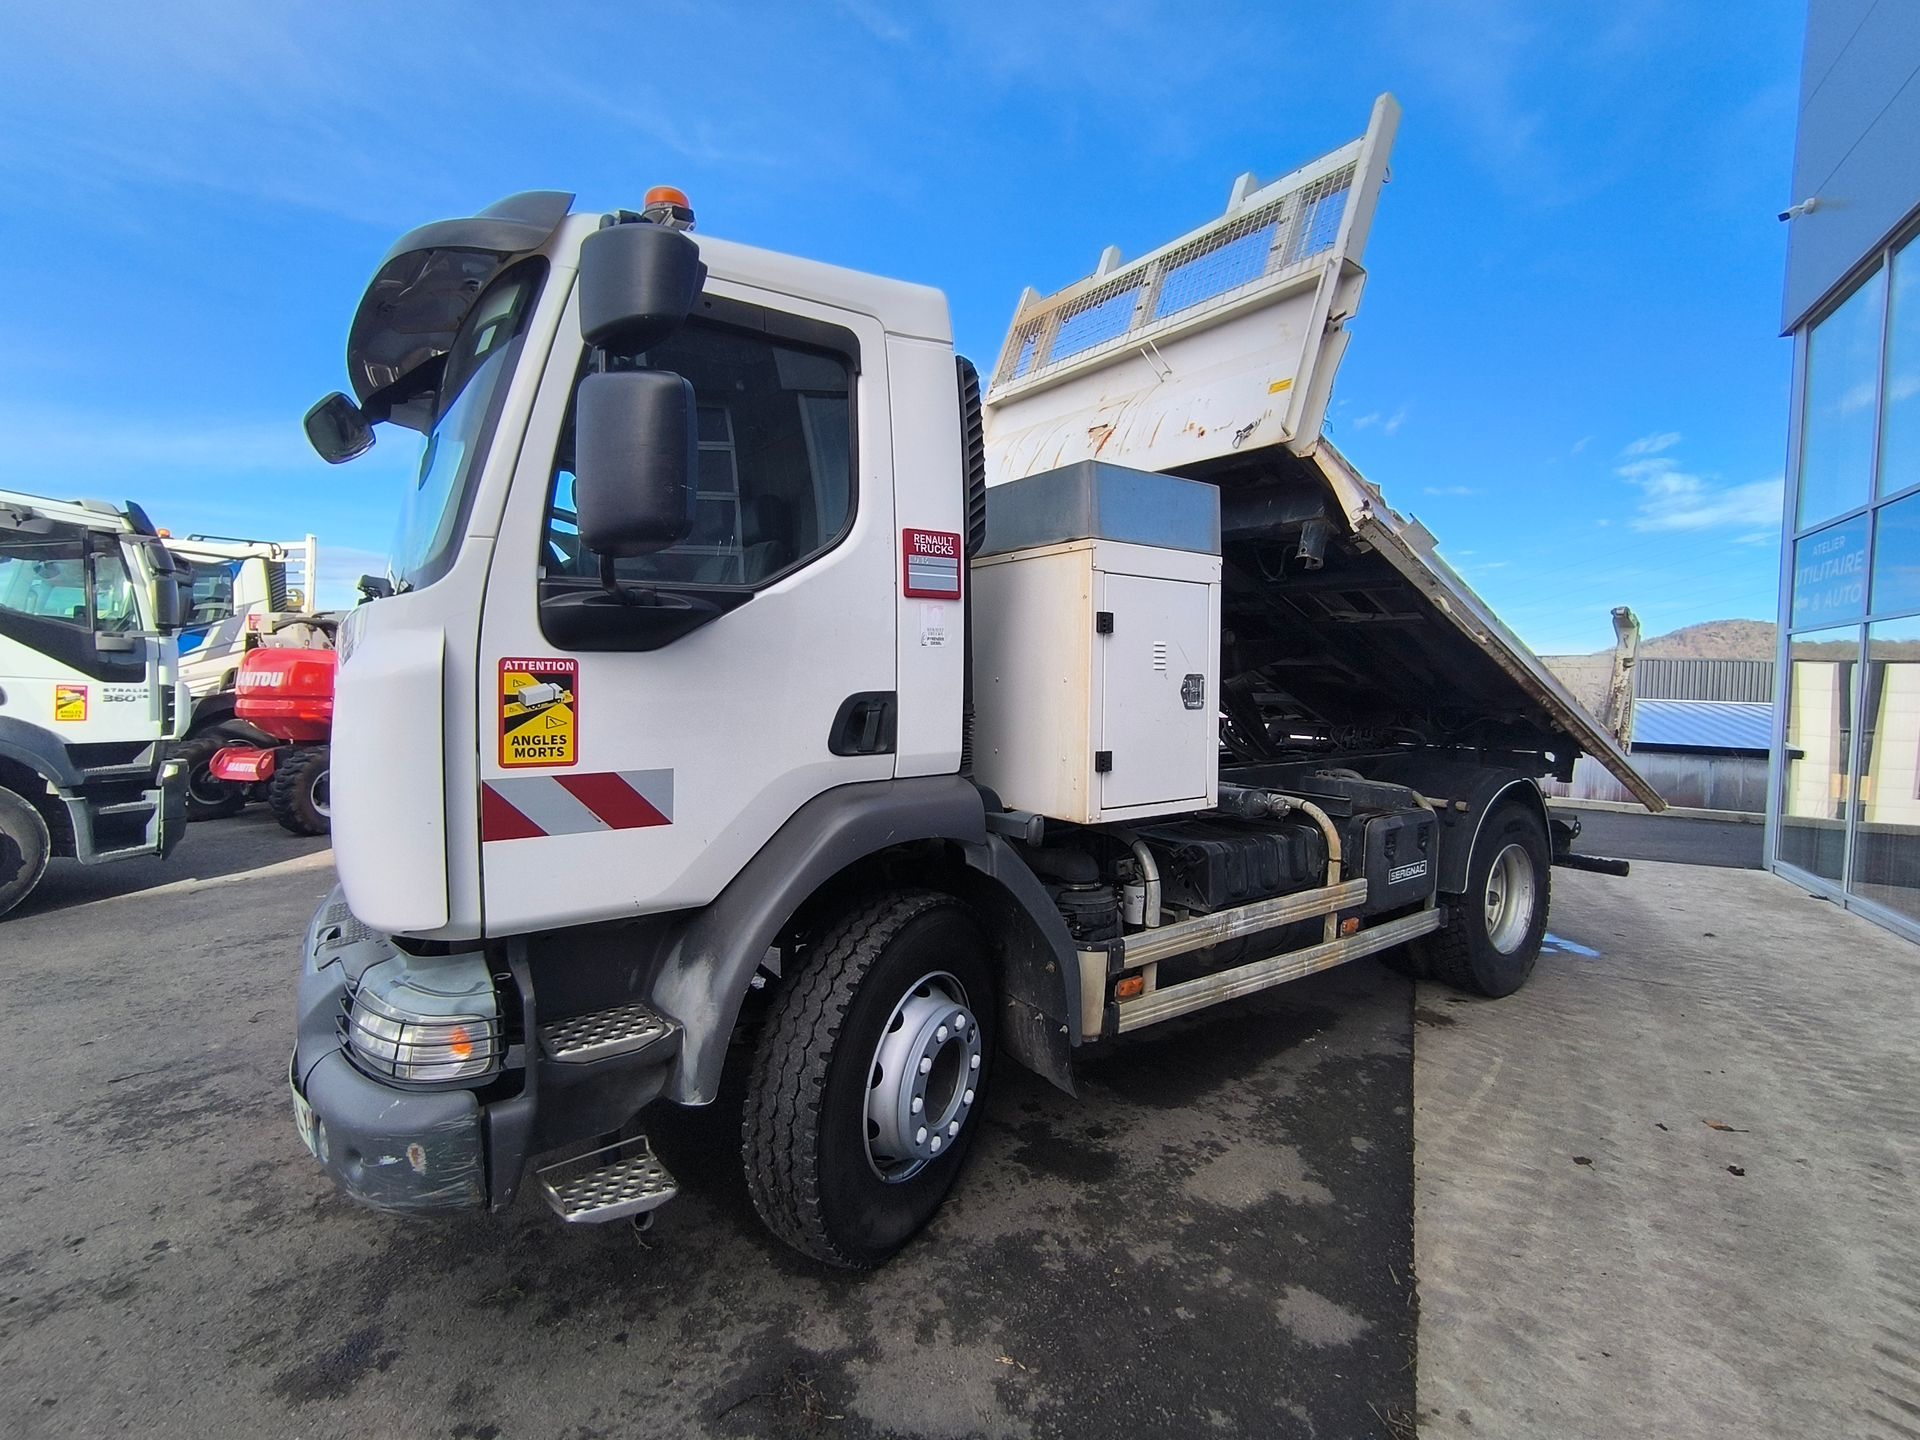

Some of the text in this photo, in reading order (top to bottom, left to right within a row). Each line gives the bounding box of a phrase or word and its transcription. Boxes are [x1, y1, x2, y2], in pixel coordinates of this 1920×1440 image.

[913, 533, 954, 546] RENAULT
[1812, 535, 1846, 556] ATELIER
[913, 542, 954, 555] TRUCKS
[1823, 583, 1862, 609] AUTO
[503, 660, 575, 671] ATTENTION
[102, 694, 136, 702] 360
[511, 734, 567, 746] ANGLES
[514, 746, 565, 758] MORTS
[1390, 863, 1425, 881] SERIGNAC
